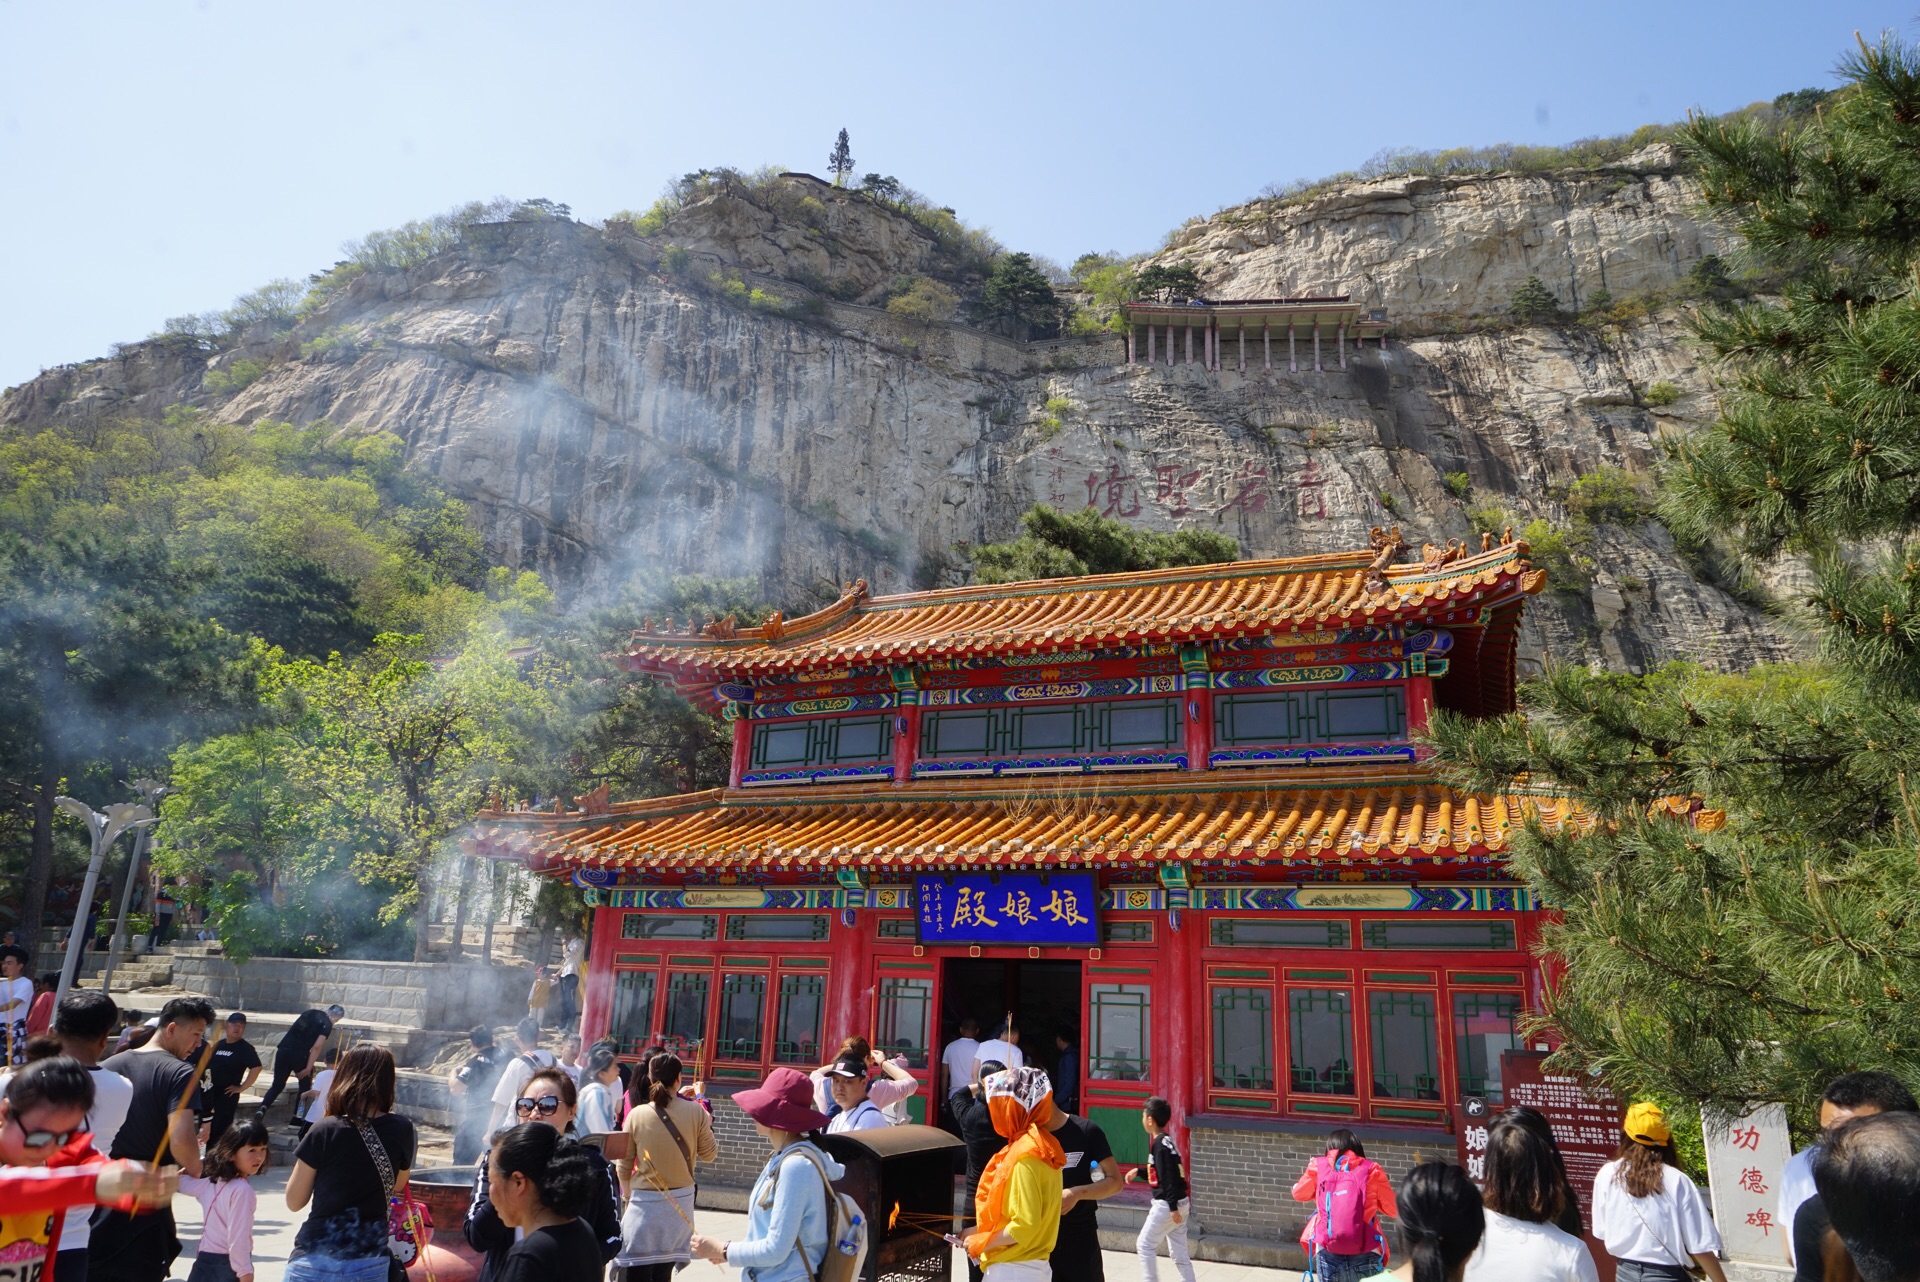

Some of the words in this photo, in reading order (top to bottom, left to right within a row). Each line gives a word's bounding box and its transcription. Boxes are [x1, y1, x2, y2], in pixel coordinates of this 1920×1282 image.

[951, 886, 1089, 929] 娘娘殿
[1732, 1125, 1774, 1237] 功德碑
